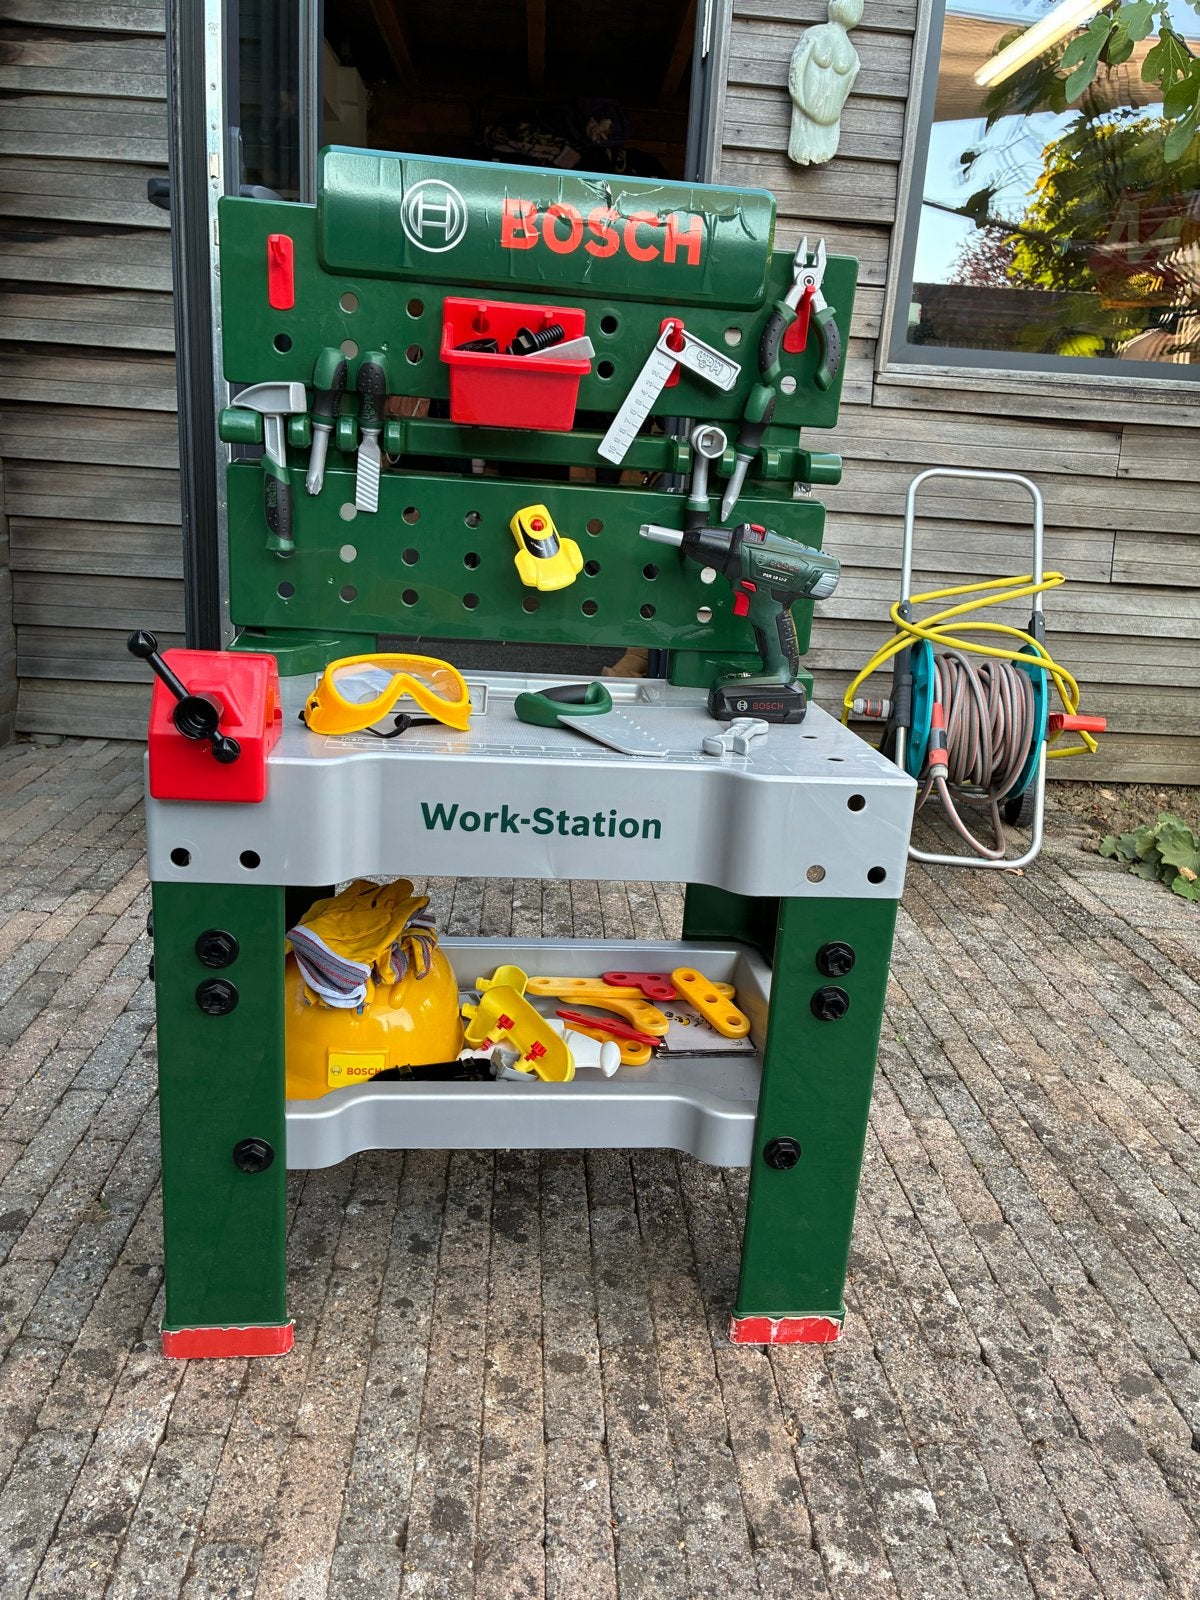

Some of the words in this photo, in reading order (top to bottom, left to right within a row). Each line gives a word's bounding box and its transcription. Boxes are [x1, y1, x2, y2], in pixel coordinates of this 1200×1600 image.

[501, 198, 703, 266] BOSCH
[752, 702, 784, 711] BOSCH
[421, 802, 662, 839] Work-Station
[346, 1067, 382, 1076] BOSCH
